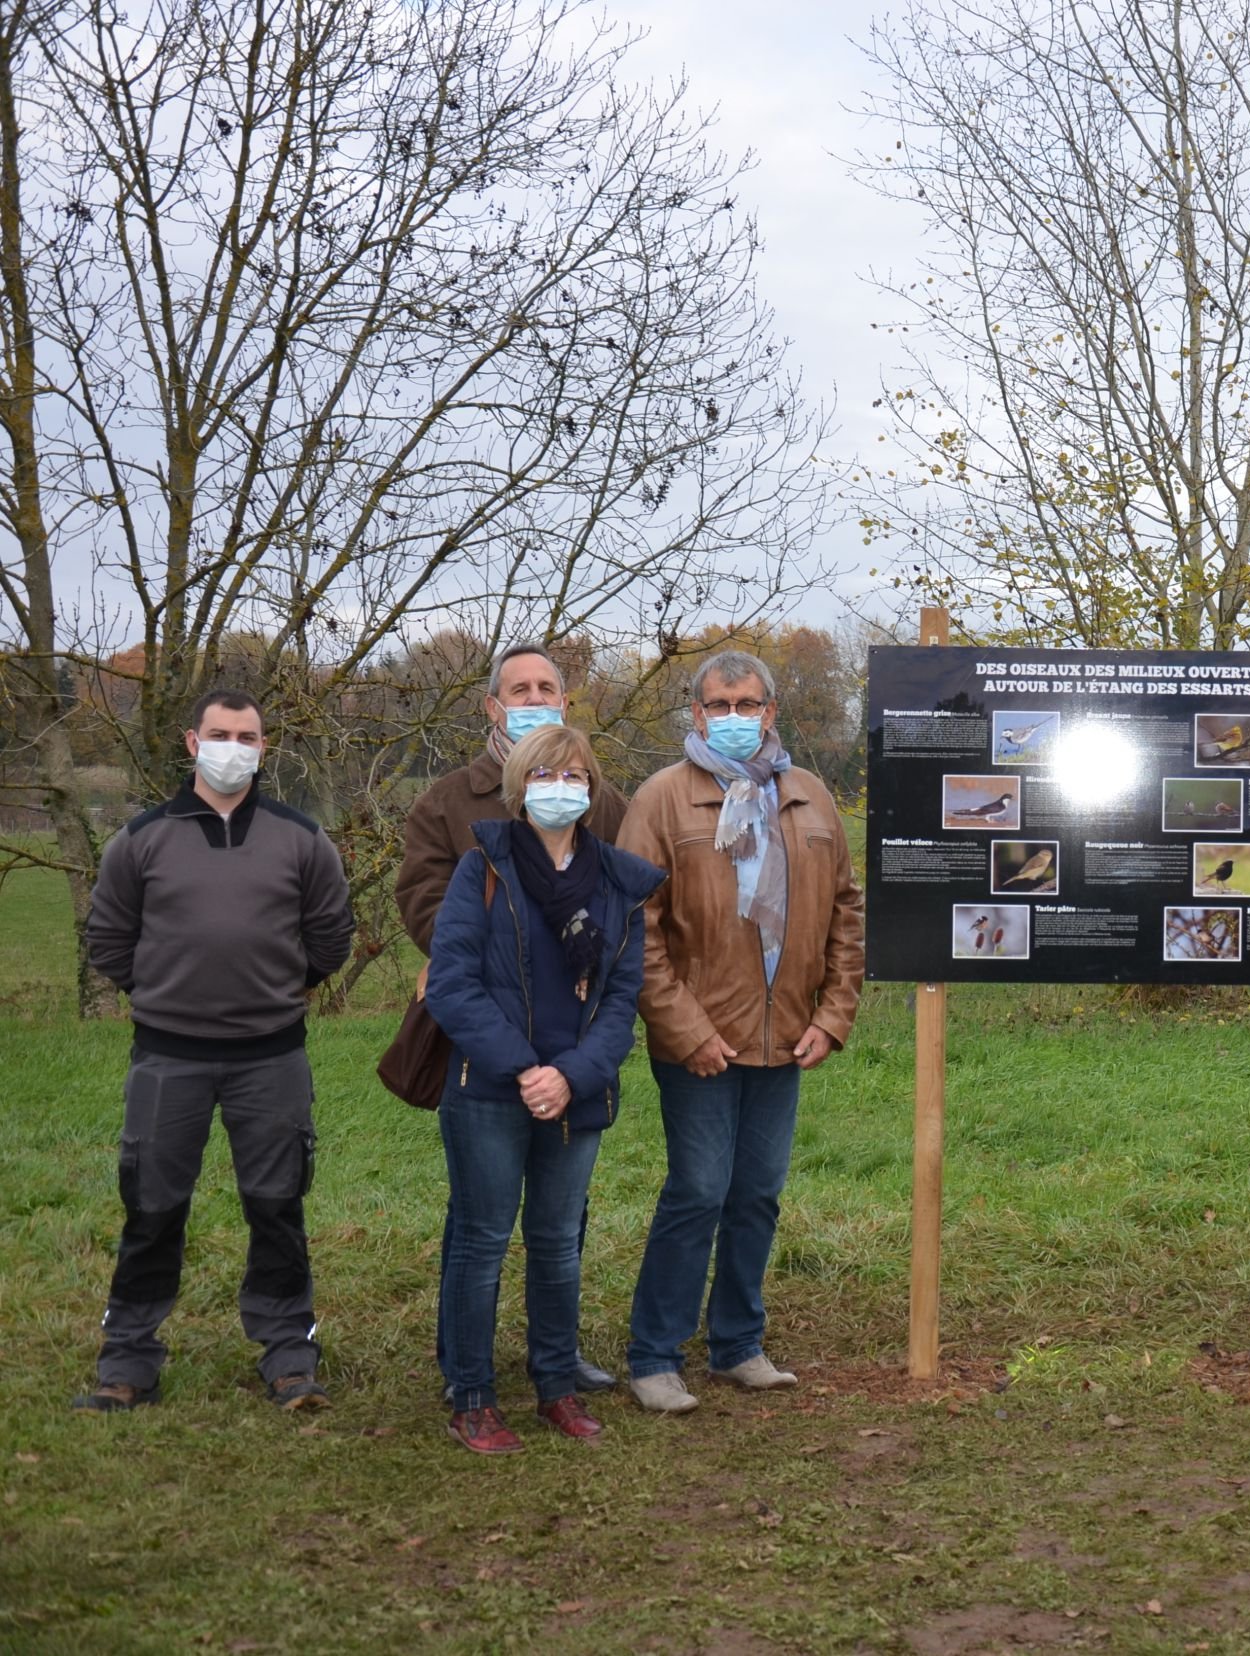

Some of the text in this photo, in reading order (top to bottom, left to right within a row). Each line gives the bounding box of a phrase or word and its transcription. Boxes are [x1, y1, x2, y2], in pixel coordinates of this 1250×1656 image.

[976, 663, 1007, 675] DES
[1010, 664, 1082, 676] OISEAUX
[1085, 665, 1116, 676] DES
[1118, 666, 1185, 678] MILIEUX
[983, 680, 1049, 692] AUTOUR
[1052, 682, 1073, 692] DE
[1076, 679, 1144, 694] L'ÉTANG
[1147, 683, 1177, 694] DES
[883, 709, 932, 717] Bergeronnette
[1085, 841, 1128, 849] Rougequeue
[1057, 905, 1076, 913] pâtre
